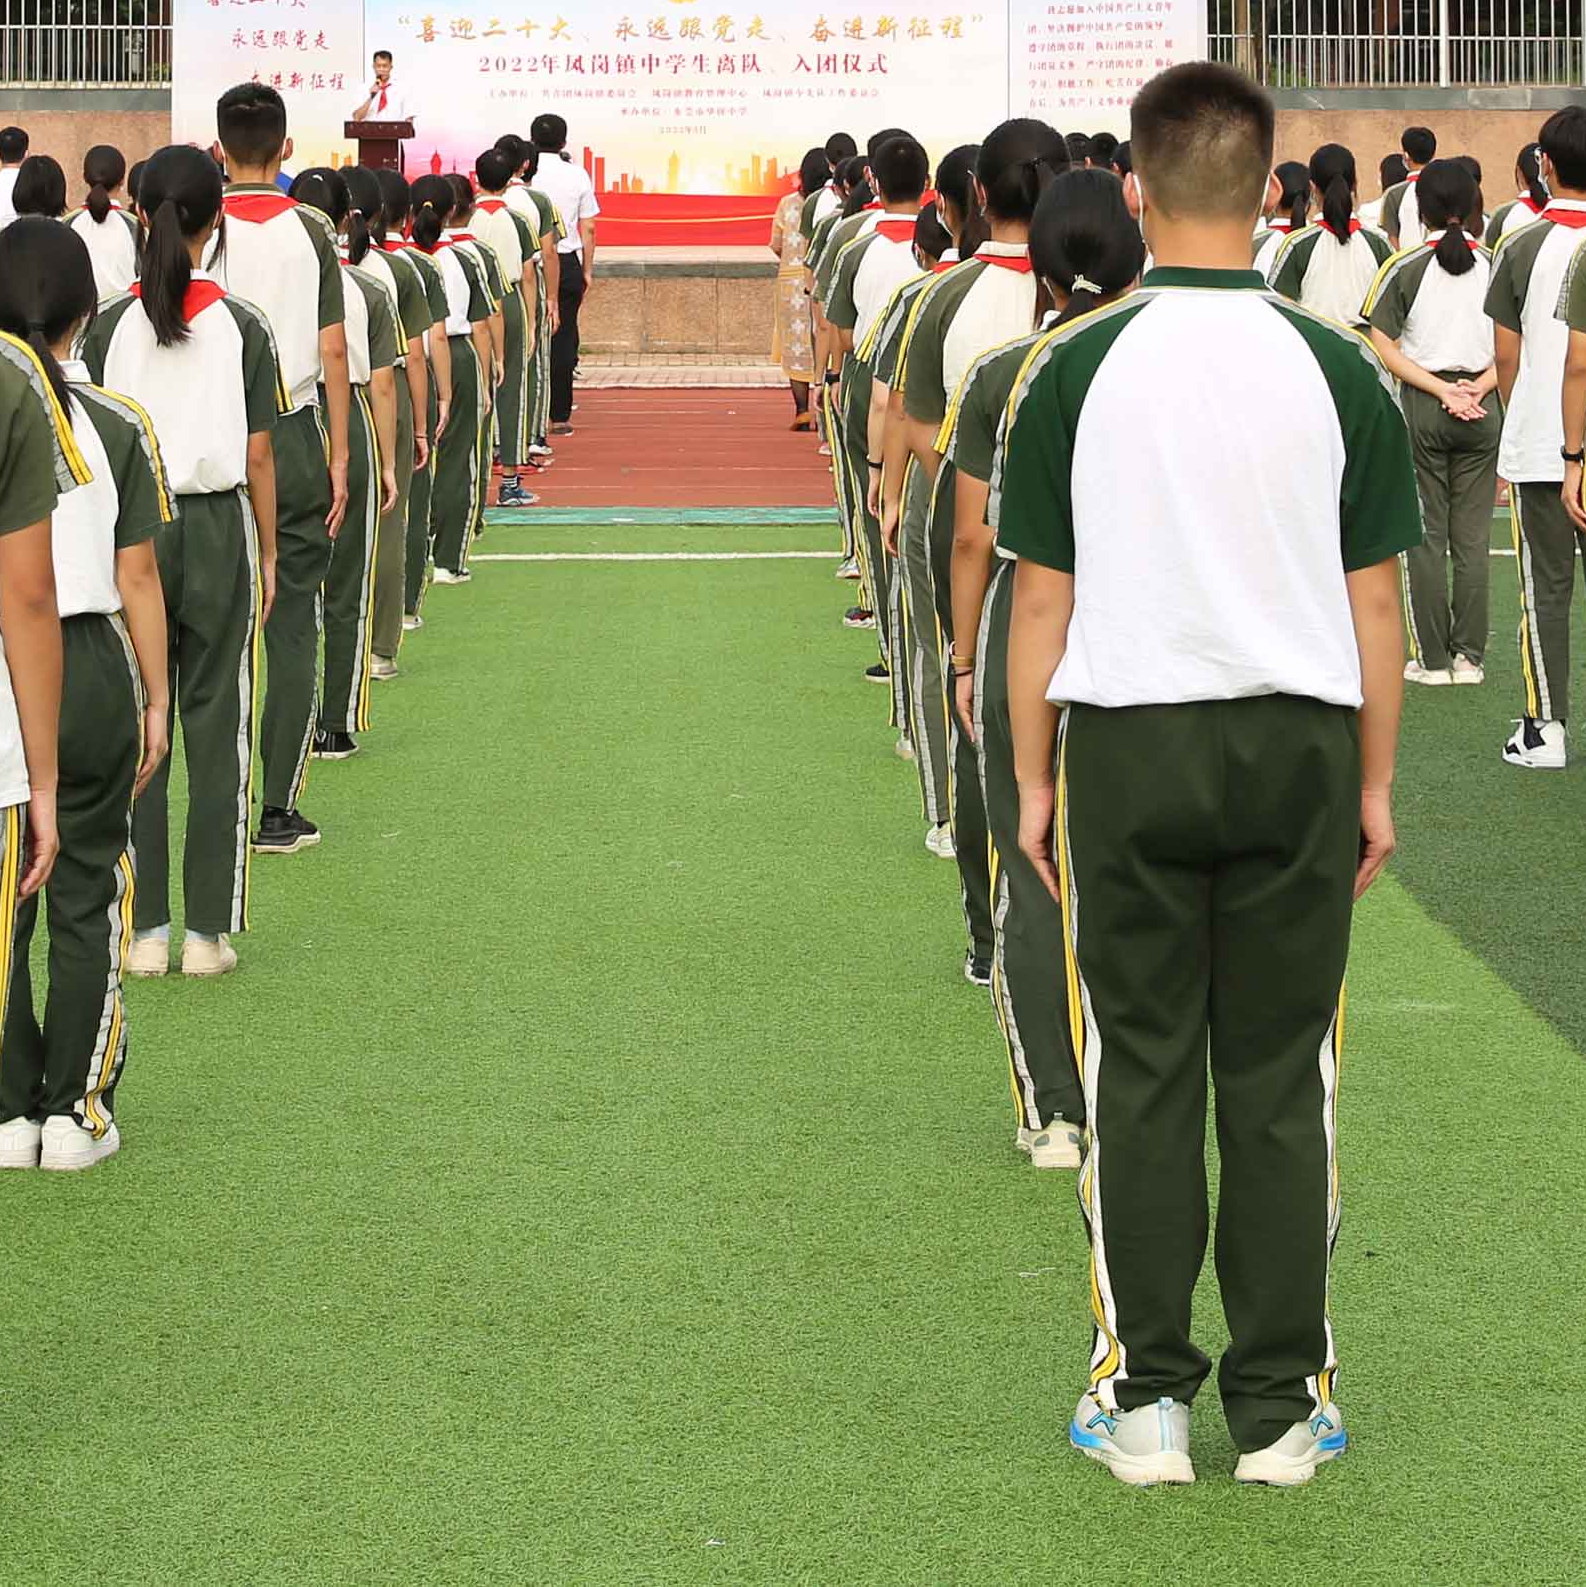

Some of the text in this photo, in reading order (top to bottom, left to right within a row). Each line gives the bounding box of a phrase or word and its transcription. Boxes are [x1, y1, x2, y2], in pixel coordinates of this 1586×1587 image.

[232, 28, 330, 51] 永远跟党走
